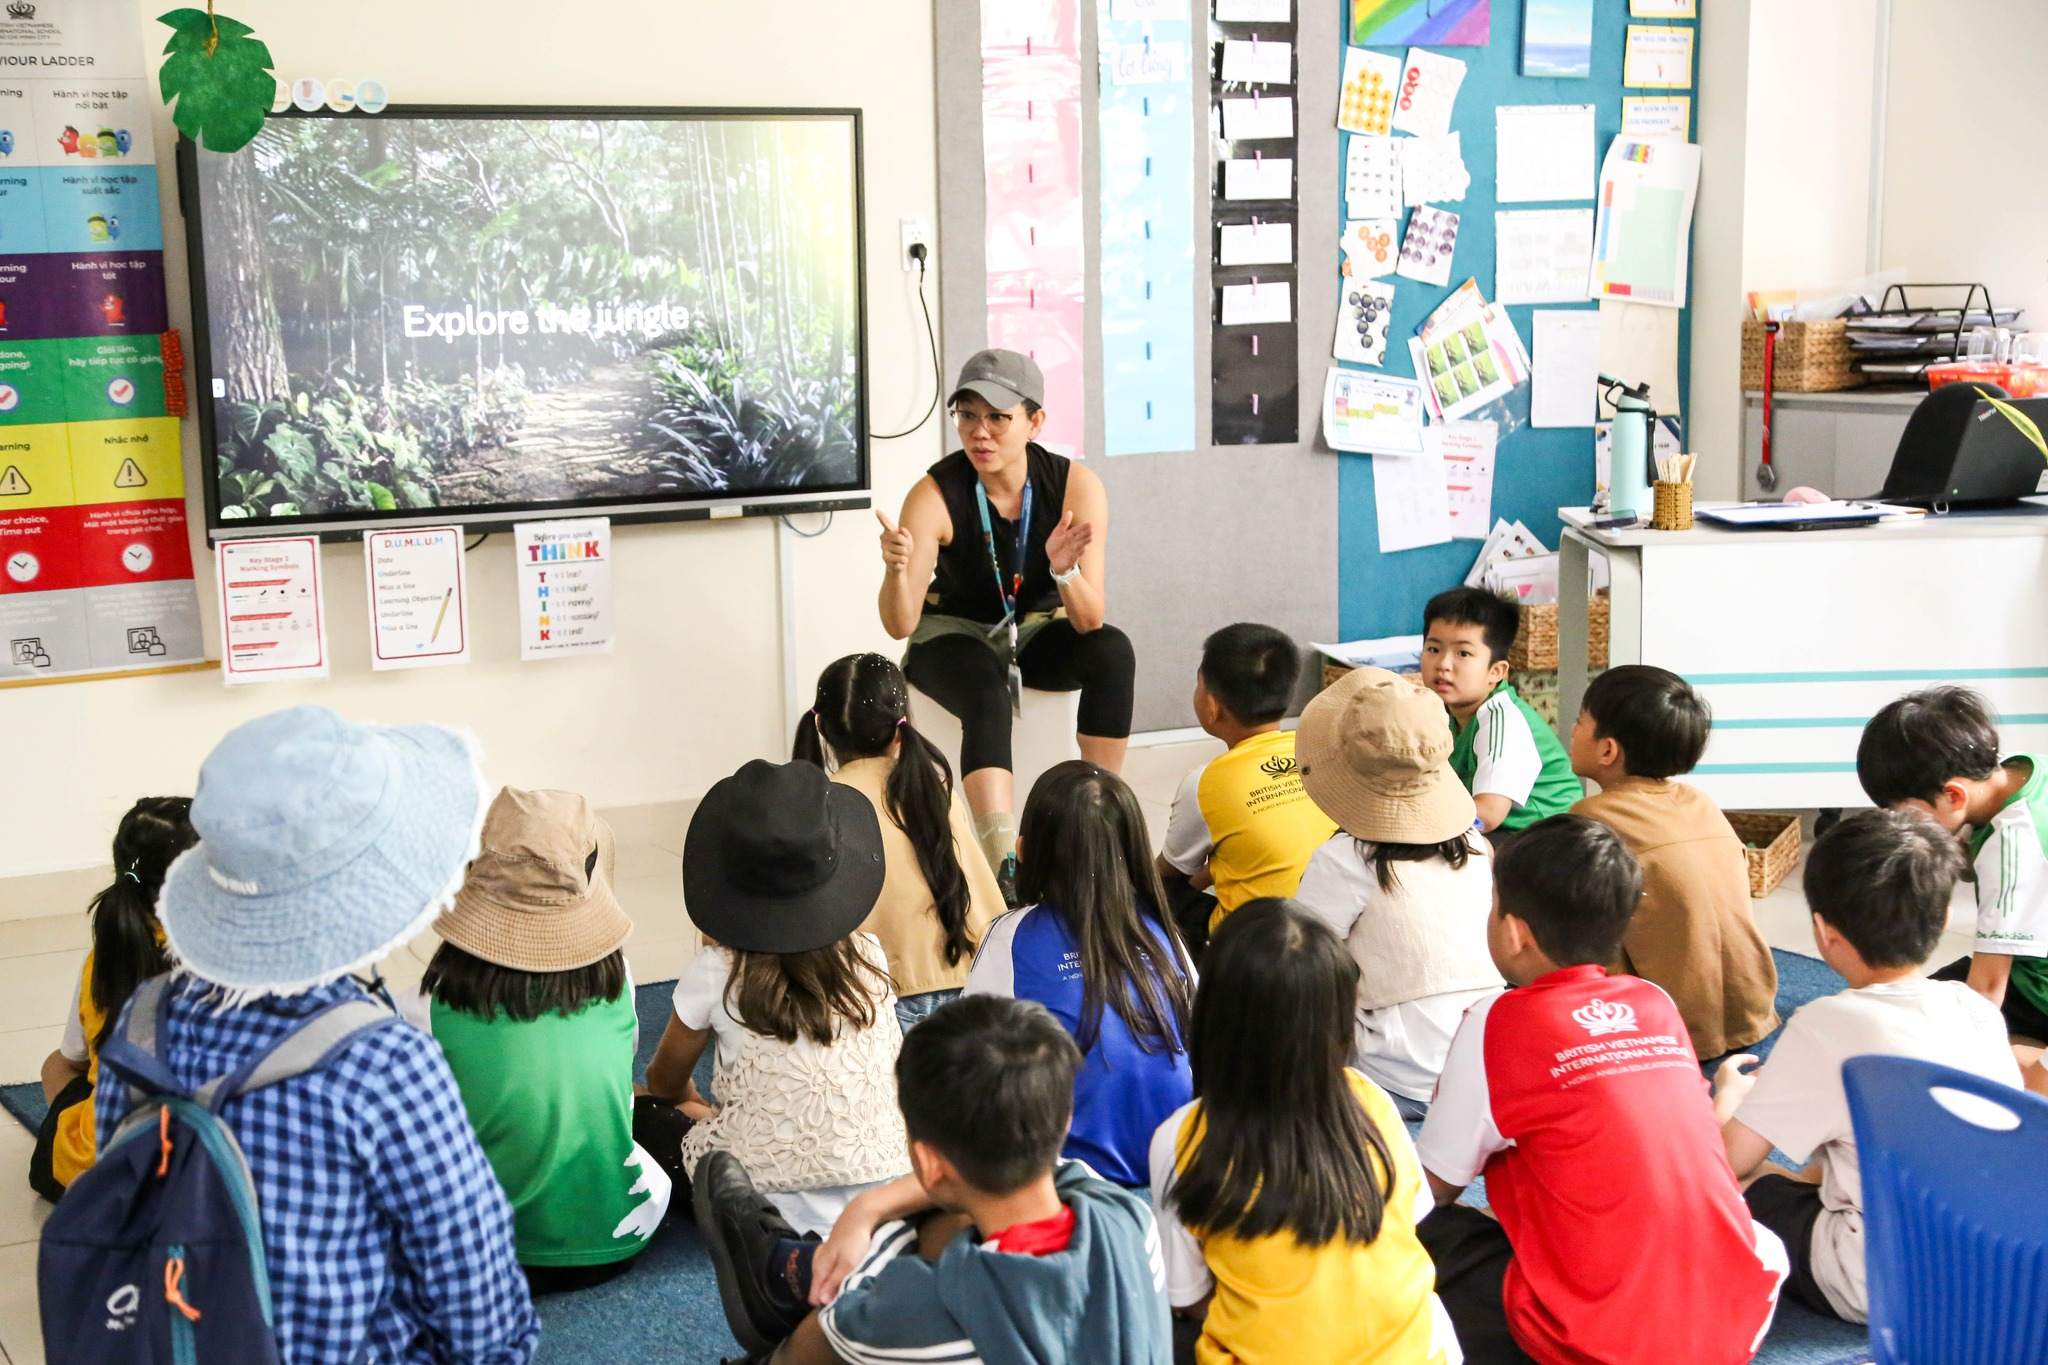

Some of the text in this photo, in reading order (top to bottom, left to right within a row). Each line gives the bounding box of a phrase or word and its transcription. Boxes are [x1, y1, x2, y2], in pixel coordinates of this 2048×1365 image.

[41, 56, 95, 66] LADDER
[403, 300, 690, 344] Explore the jungle
[528, 540, 600, 562] THINK
[538, 571, 546, 583] T
[537, 586, 549, 597] H
[540, 629, 550, 641] K
[1249, 778, 1302, 798] BRITISH VIET
[1057, 960, 1081, 972] INTE
[1555, 1043, 1606, 1062] BRITISH
[1551, 1048, 1653, 1078] INTERNATIONAL
